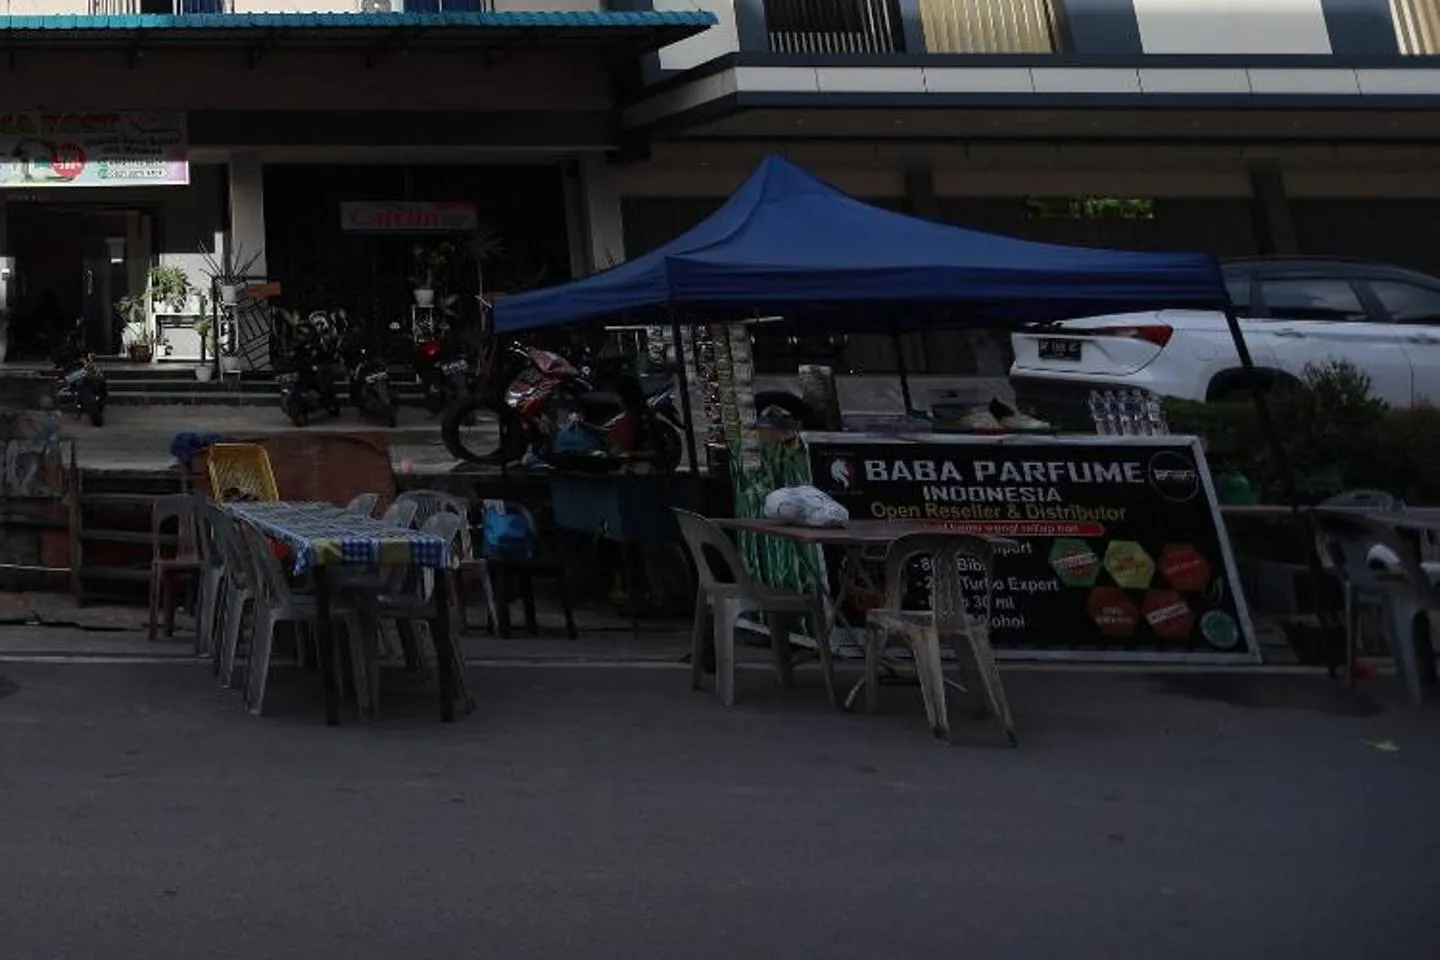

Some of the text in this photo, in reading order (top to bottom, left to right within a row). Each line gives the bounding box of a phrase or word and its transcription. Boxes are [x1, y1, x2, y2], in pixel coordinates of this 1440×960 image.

[864, 459, 963, 482] BABA
[973, 460, 1145, 484] PARFUME
[922, 485, 1063, 503] INDONESIA
[870, 500, 1127, 522] Open Reseller & Distributor
